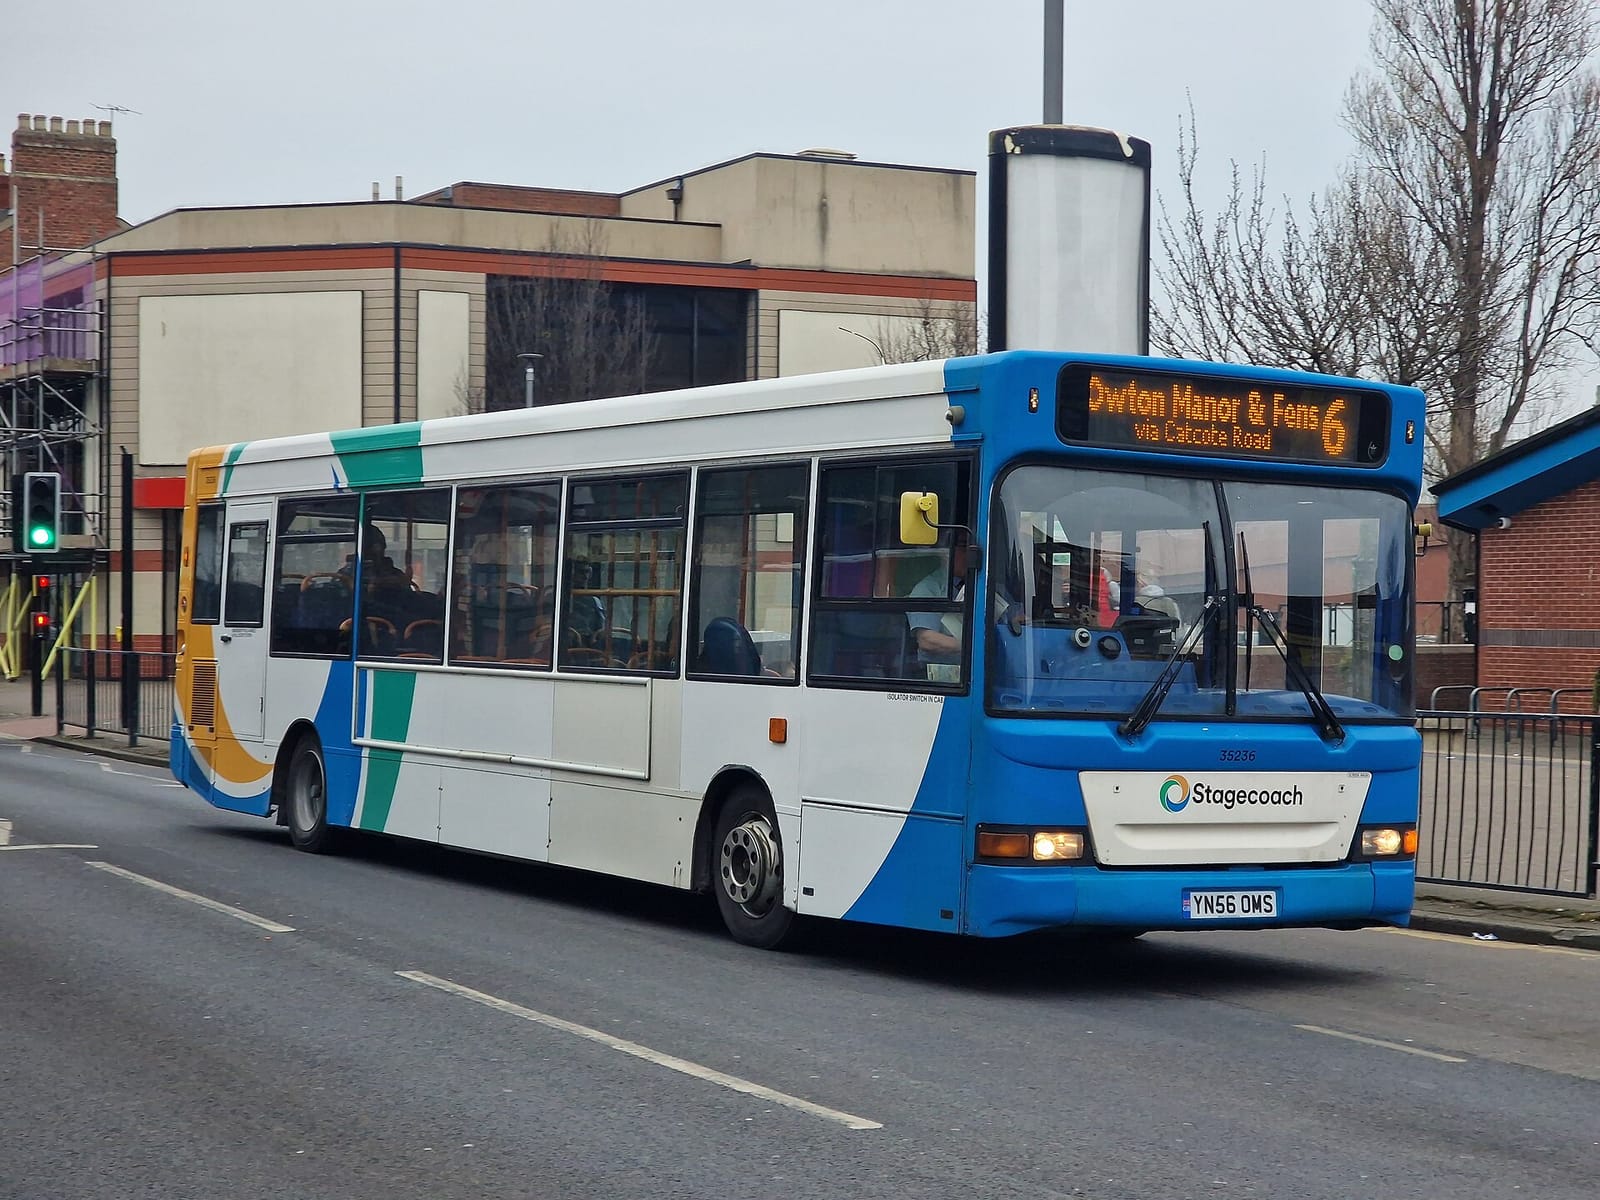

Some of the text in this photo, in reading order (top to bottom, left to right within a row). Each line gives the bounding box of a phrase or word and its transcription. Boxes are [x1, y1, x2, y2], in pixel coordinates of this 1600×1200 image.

[1172, 383, 1241, 424] Manor
[1247, 391, 1266, 426] &
[1273, 392, 1319, 430] Fens
[1134, 417, 1271, 450] via Catcote Road
[1321, 398, 1346, 456] 6
[1219, 750, 1256, 761] 35236
[1192, 782, 1303, 809] Stagecoach
[1193, 894, 1273, 914] YN56 OMS
